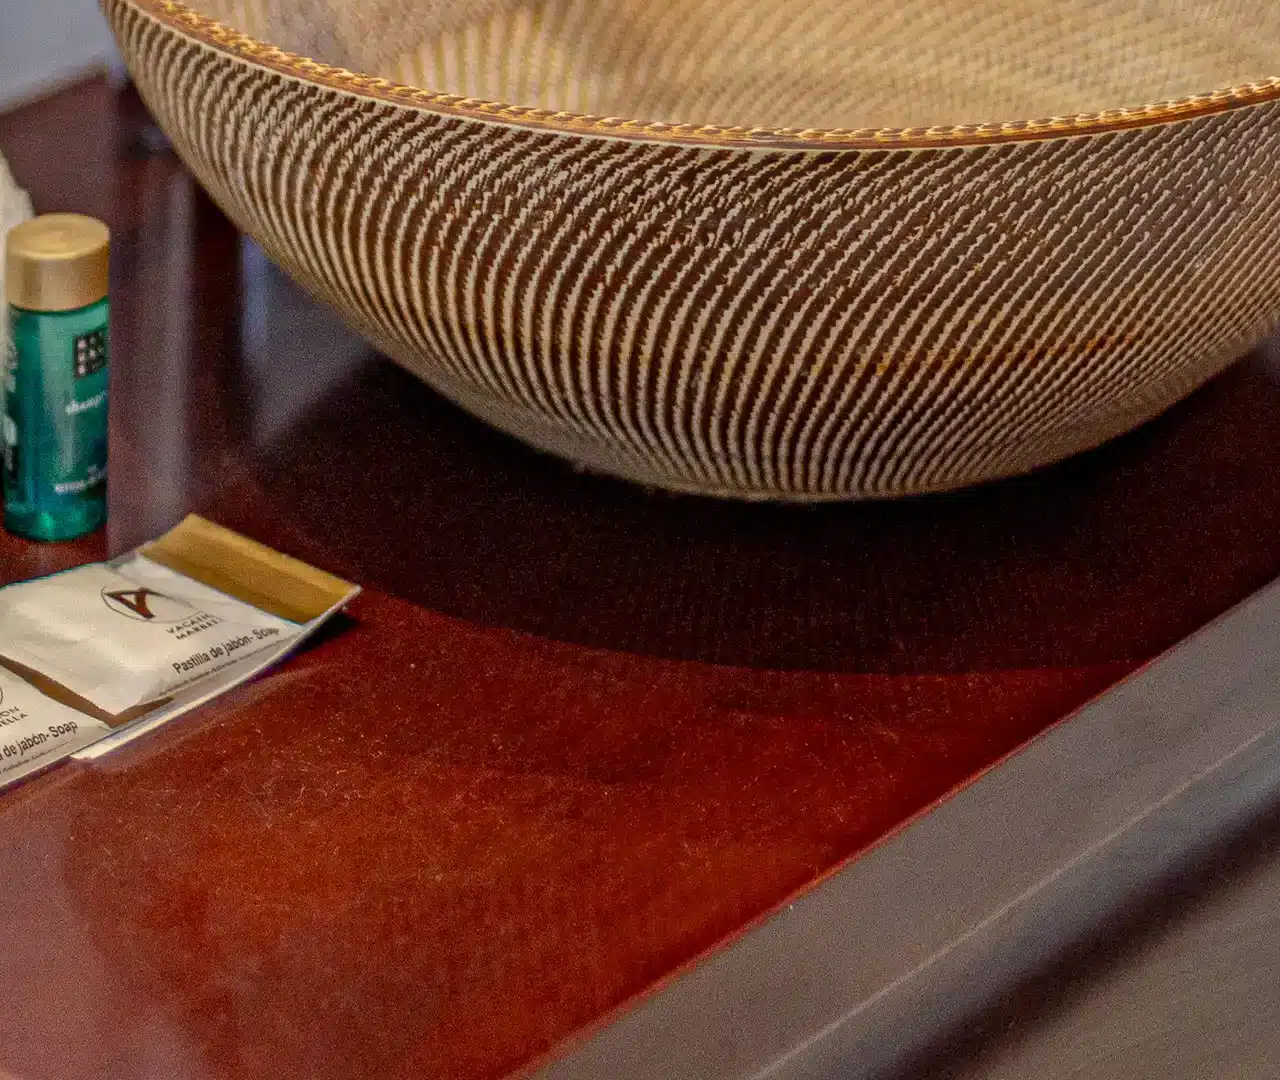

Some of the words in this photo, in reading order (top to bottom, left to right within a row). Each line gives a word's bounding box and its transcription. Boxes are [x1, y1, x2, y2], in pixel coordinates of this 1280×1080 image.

[172, 651, 210, 675] Pastilla
[209, 647, 224, 659] de
[252, 626, 280, 640] Soap
[2, 744, 17, 758] de
[48, 720, 79, 739] Soap
